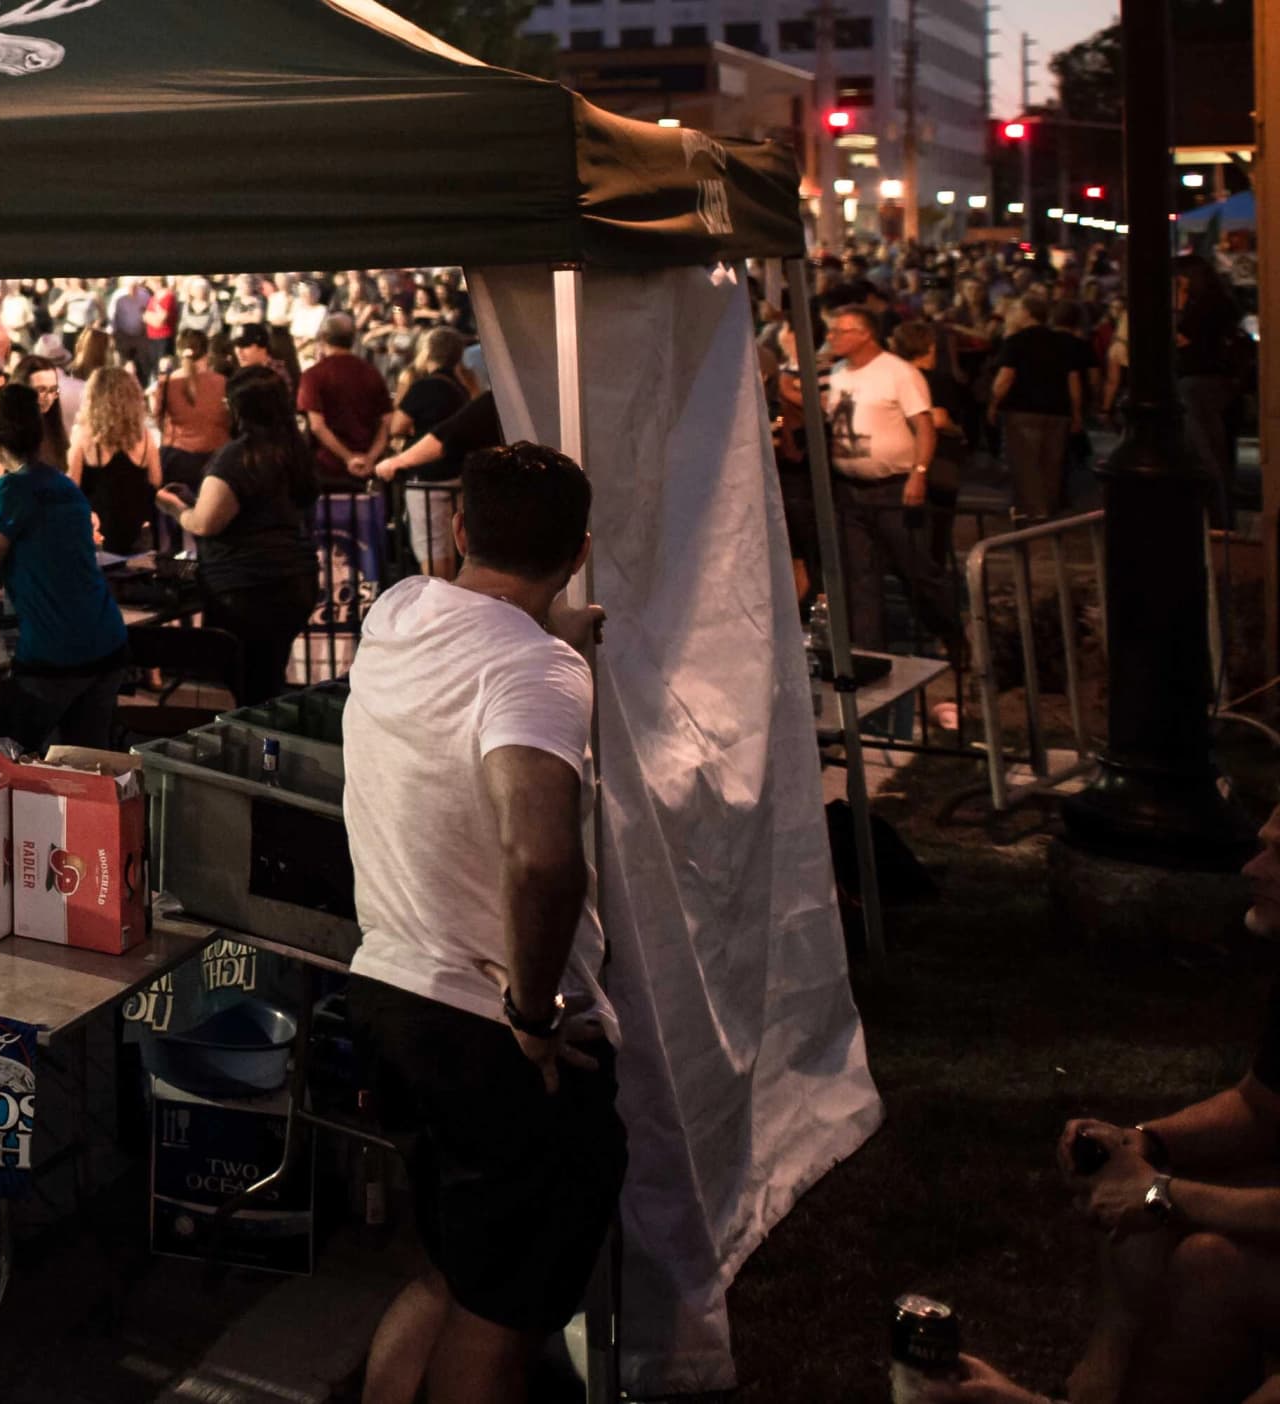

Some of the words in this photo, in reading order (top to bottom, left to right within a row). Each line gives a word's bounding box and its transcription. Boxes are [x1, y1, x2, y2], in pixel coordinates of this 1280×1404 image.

[23, 840, 35, 889] RADLER
[96, 848, 110, 905] MOOSEHEAD
[207, 1157, 260, 1180] TWO
